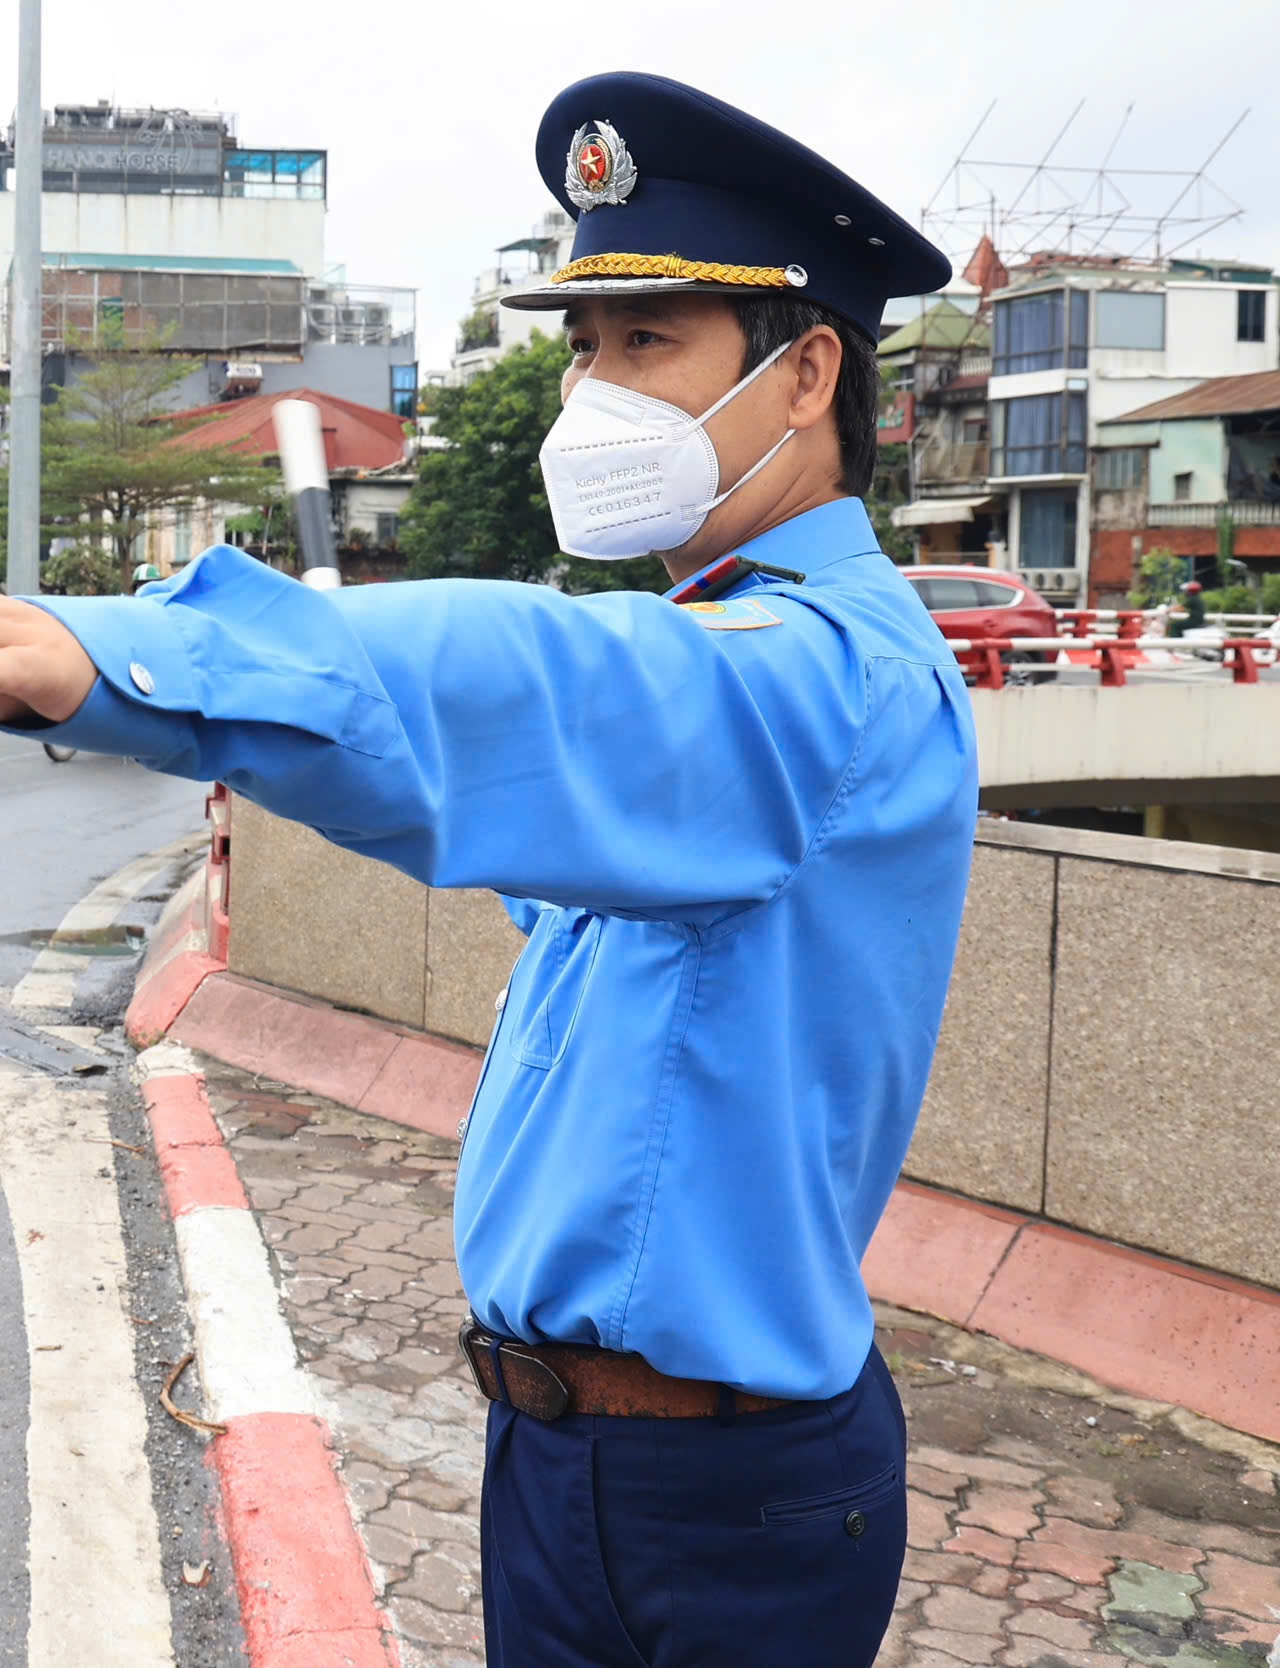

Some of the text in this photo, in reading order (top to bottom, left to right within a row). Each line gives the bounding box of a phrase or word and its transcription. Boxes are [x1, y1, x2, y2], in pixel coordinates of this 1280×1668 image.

[575, 462, 661, 489] Kichy FFP2 NR
